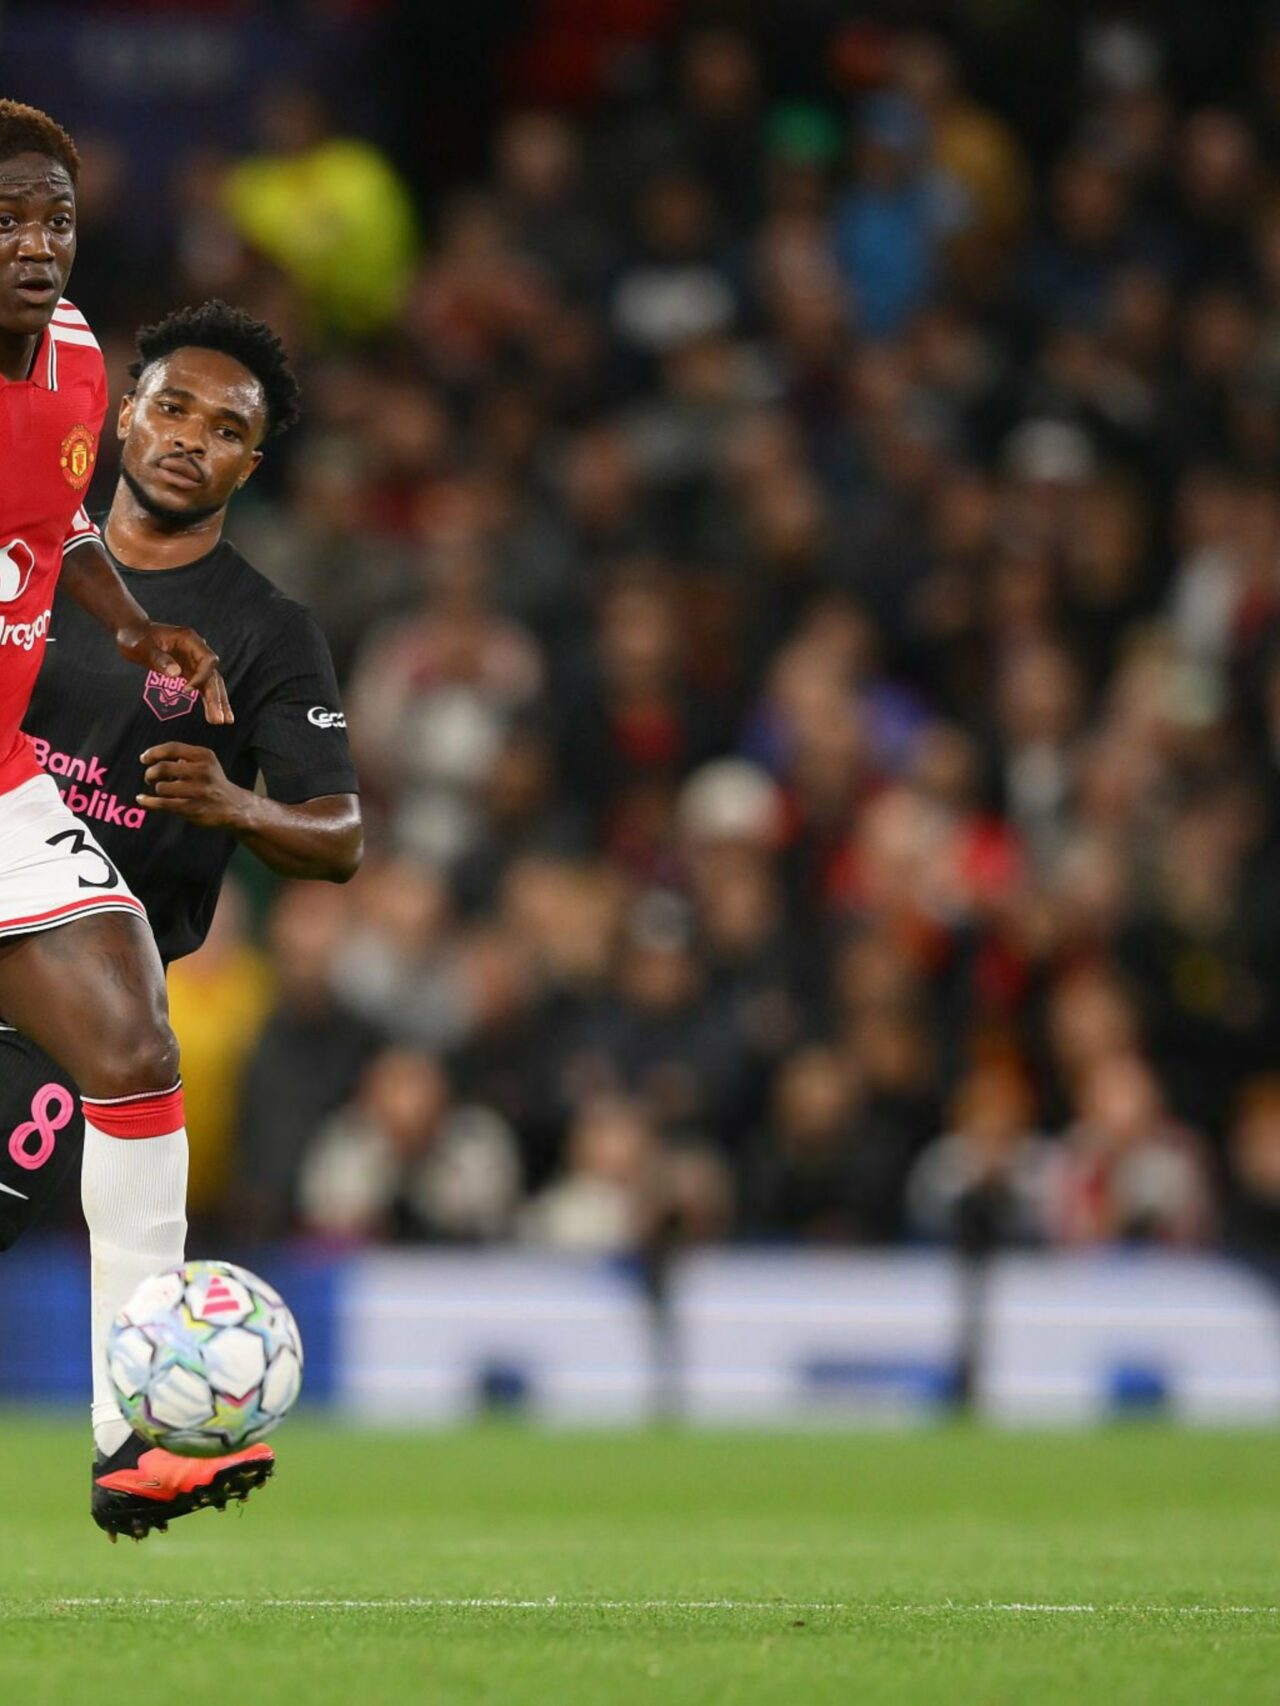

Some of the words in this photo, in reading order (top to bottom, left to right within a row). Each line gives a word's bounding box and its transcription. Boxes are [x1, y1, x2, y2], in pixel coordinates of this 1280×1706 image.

[34, 737, 108, 786] Bank
[59, 784, 146, 834] blika
[46, 829, 119, 889] 3
[8, 1082, 74, 1170] 8
